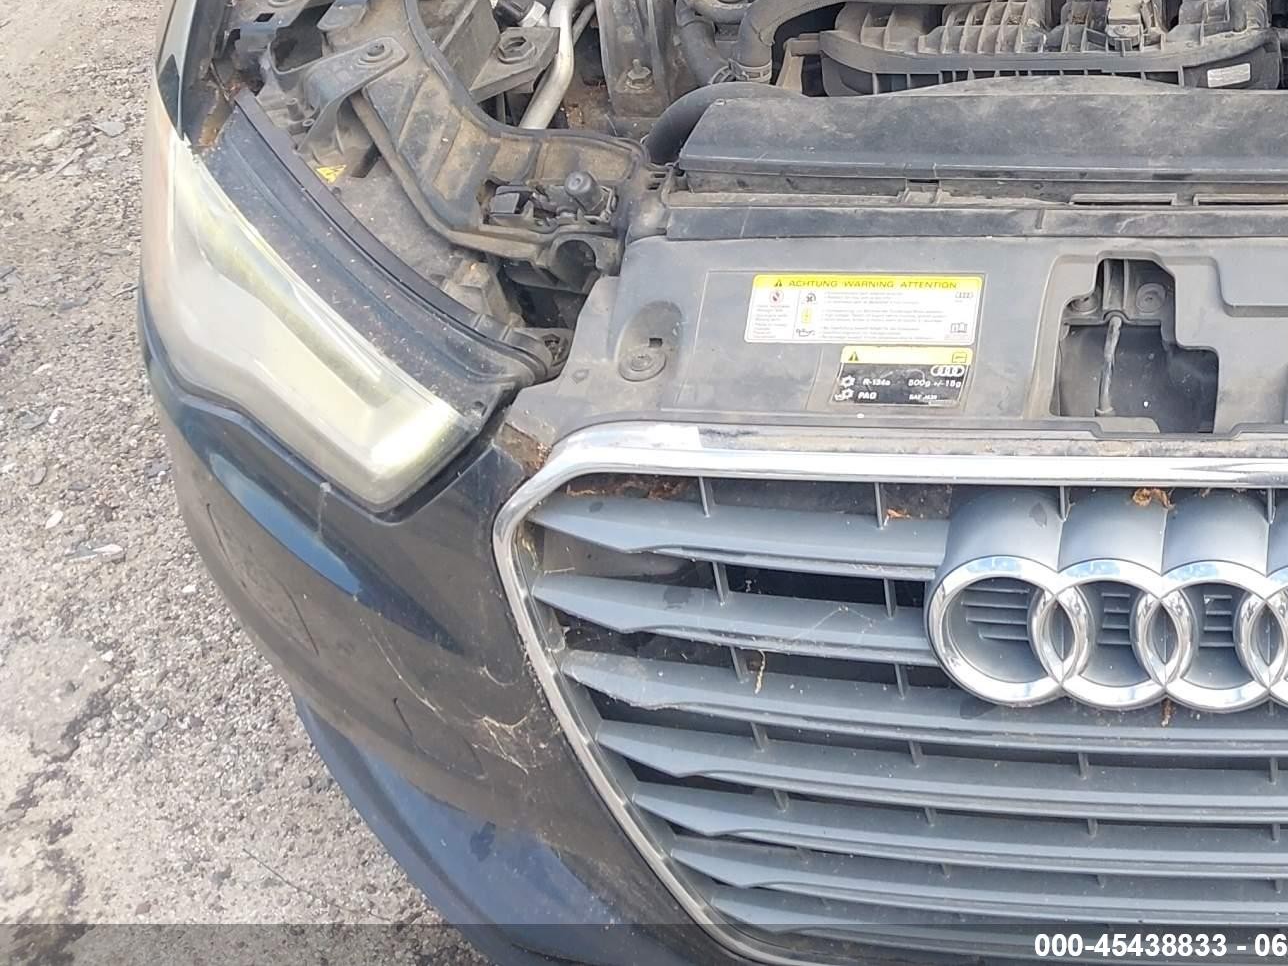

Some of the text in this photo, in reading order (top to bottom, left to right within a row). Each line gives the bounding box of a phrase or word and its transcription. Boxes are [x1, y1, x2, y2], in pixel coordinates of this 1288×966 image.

[788, 279, 958, 289] ACHTUNG WARNING ATTENTION
